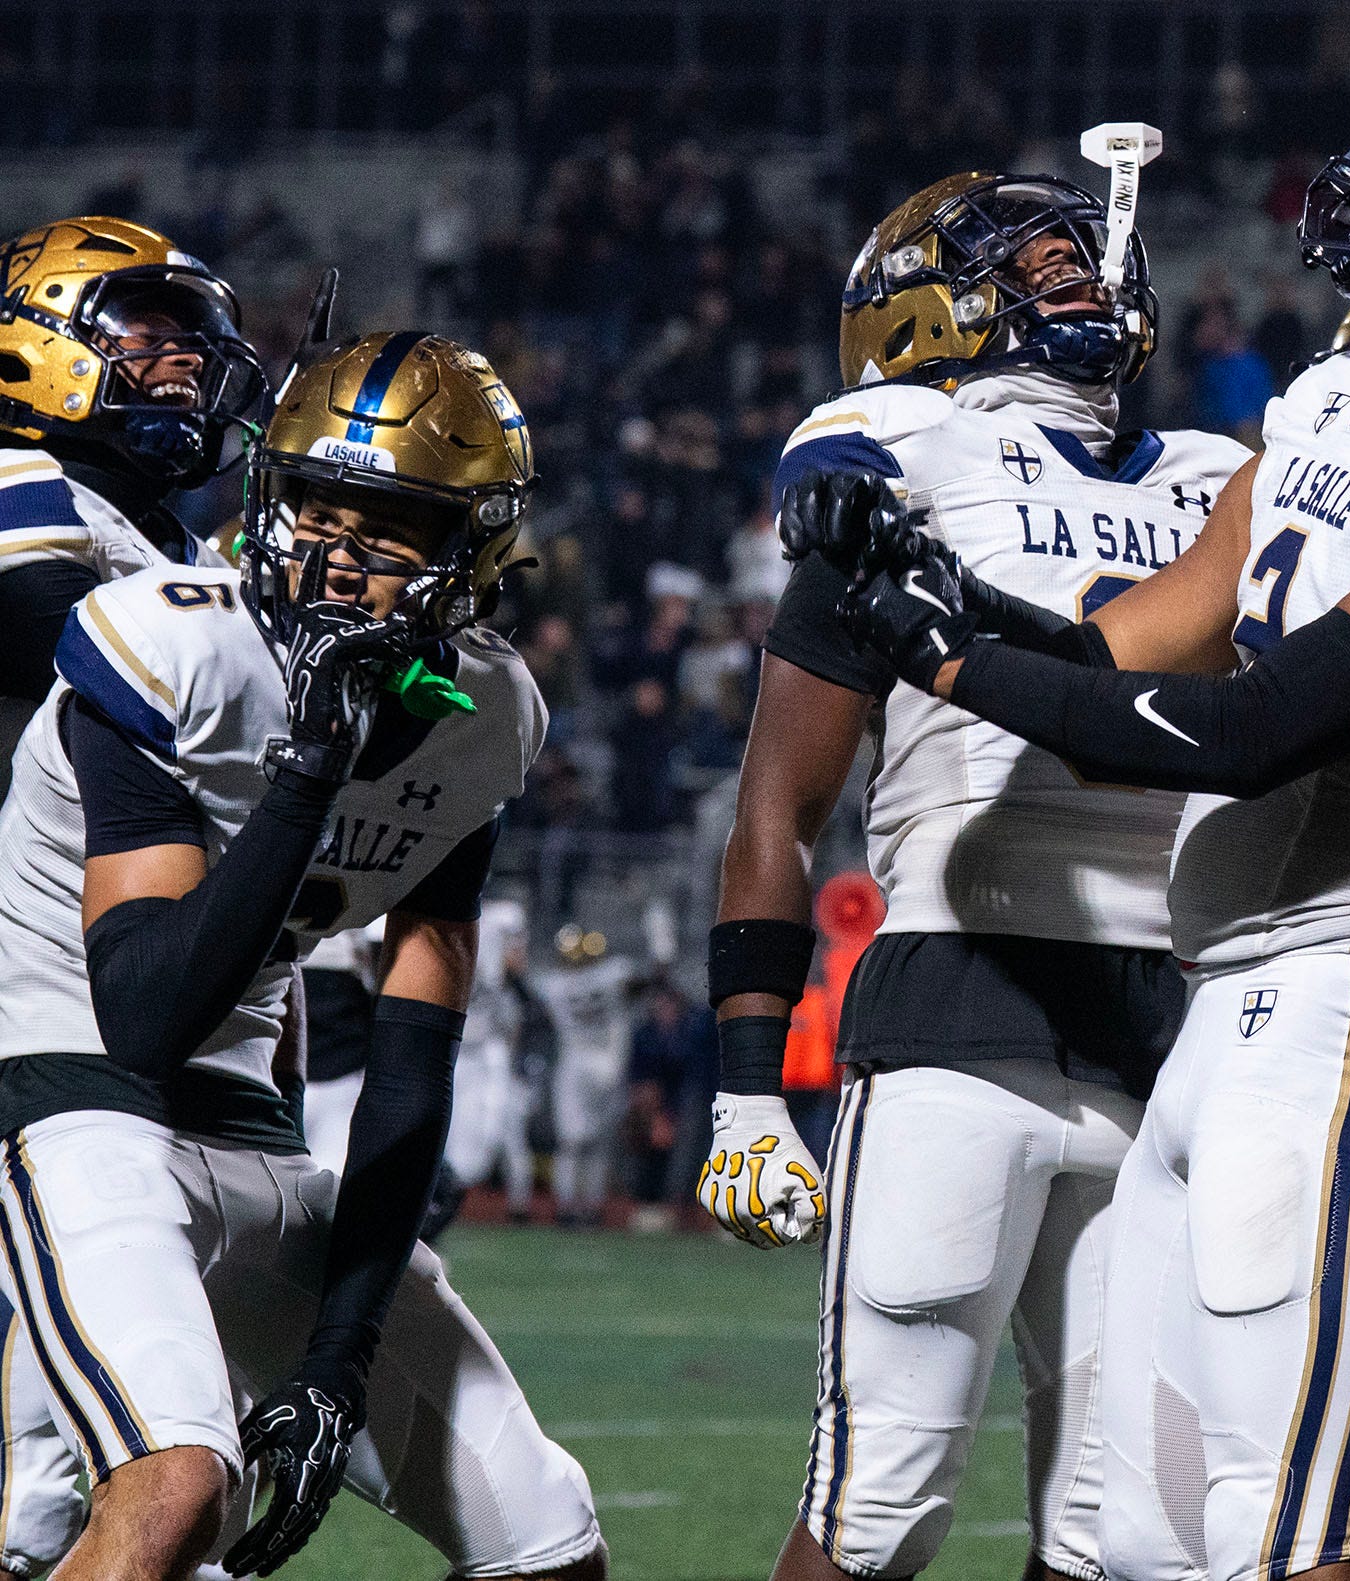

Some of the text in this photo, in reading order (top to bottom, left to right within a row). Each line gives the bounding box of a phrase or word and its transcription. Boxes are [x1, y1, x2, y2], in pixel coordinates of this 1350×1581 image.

[324, 443, 380, 469] LASALLE
[1016, 504, 1201, 570] LA SALL
[313, 815, 426, 874] ALLE
